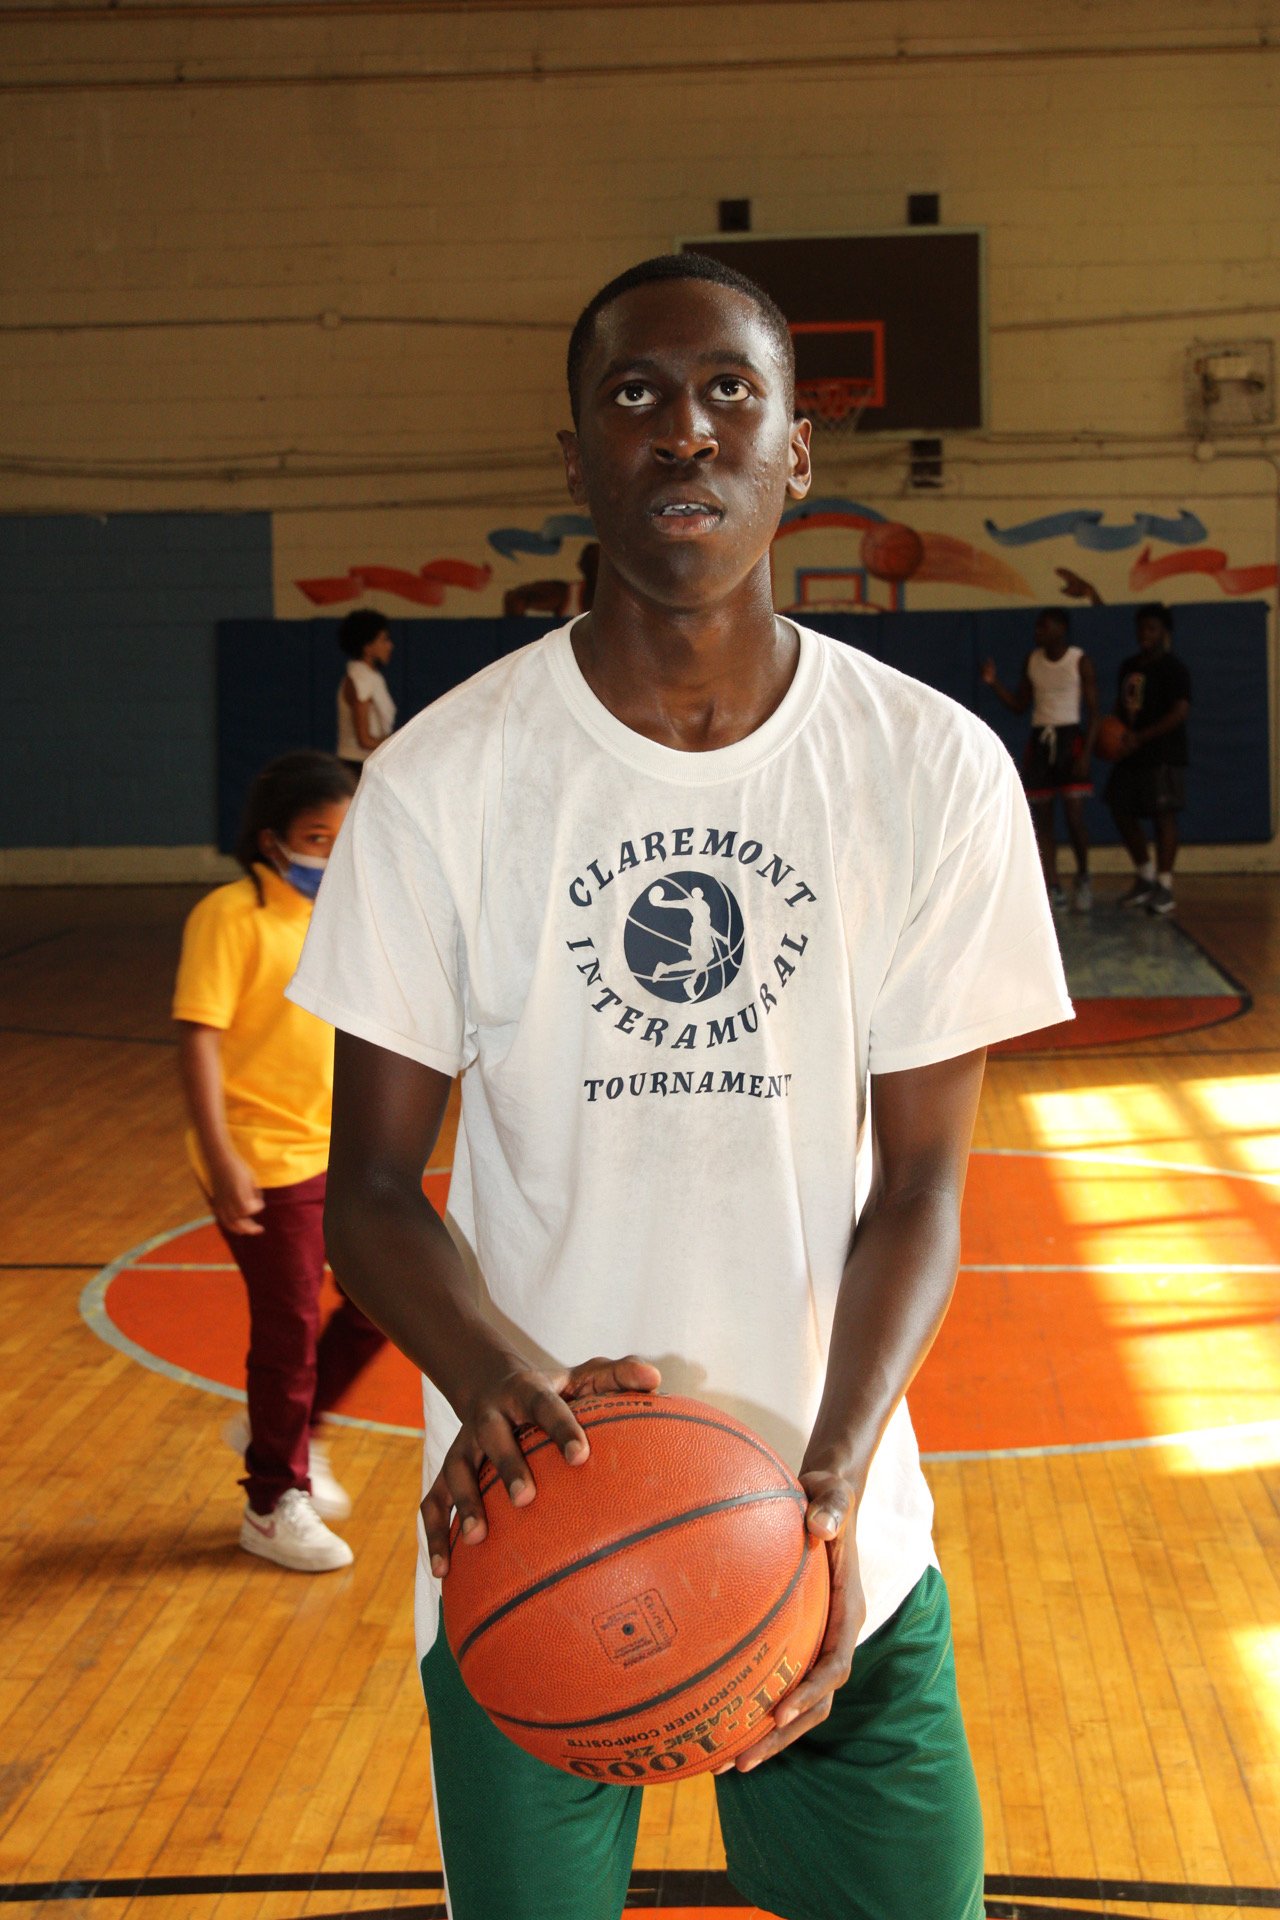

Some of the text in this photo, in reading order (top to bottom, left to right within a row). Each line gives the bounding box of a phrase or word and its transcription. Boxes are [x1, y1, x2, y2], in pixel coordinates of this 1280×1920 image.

[568, 827, 817, 907] CLAREMONT
[566, 933, 809, 1049] INTERAMURAL
[584, 1071, 792, 1102] TOURNAMENT
[663, 1665, 753, 1732] MICROFIBER
[566, 1729, 660, 1748] COMPOSITE
